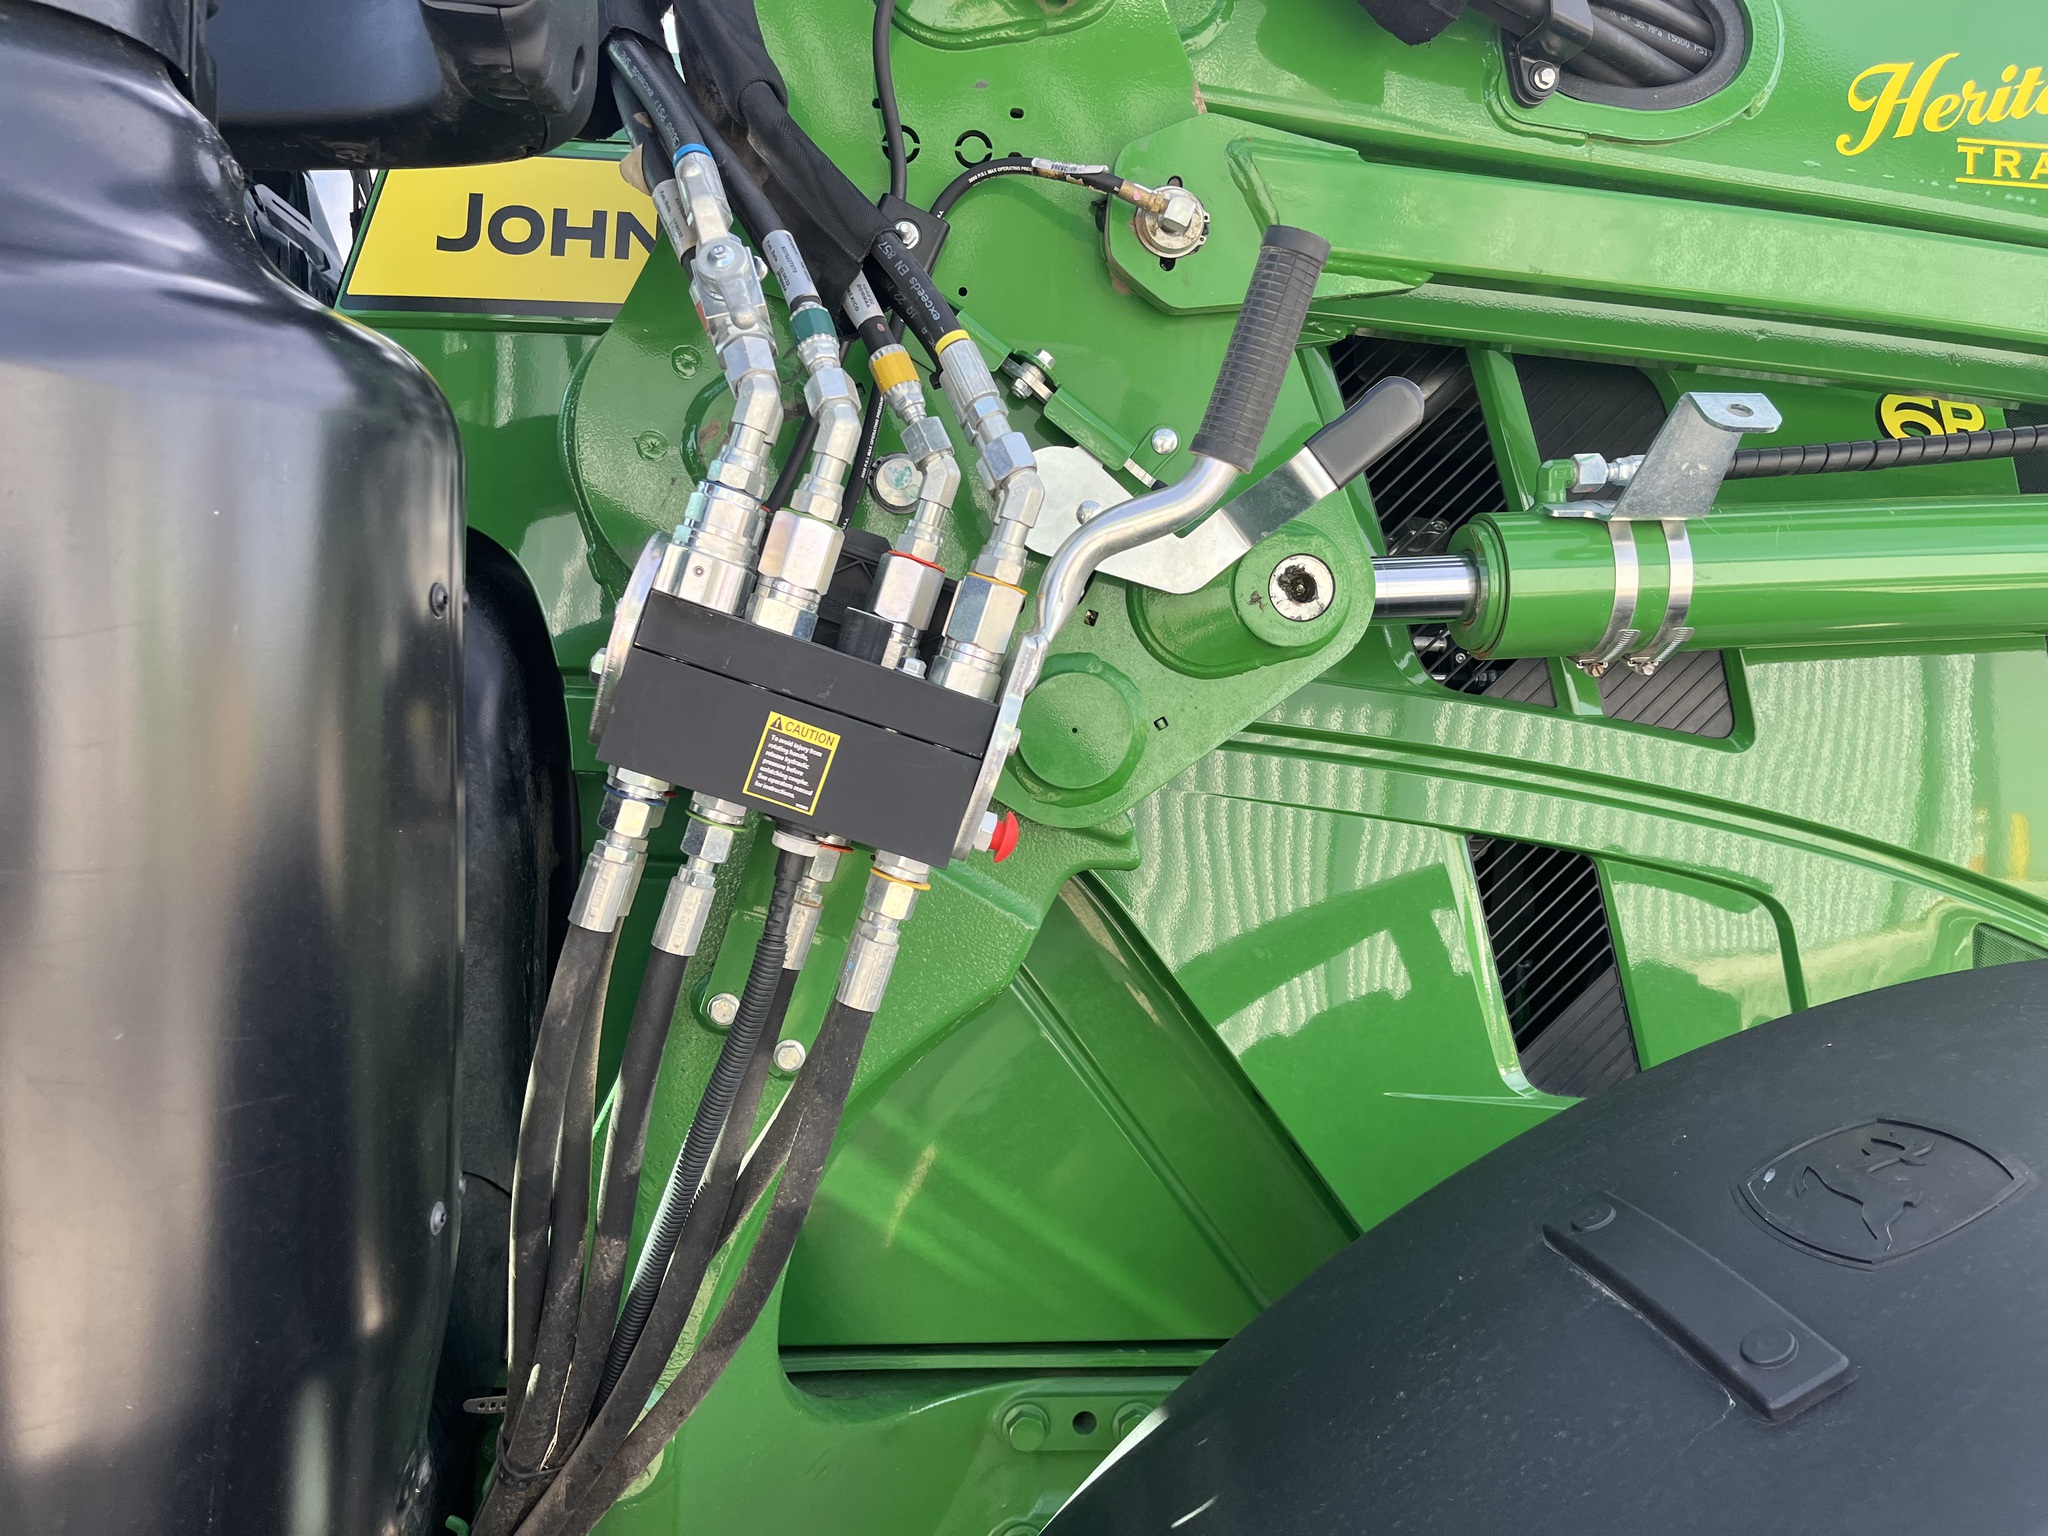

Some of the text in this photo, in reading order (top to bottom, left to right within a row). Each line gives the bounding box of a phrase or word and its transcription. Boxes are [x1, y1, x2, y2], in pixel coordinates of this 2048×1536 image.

[654, 100, 668, 121] PSI)
[666, 122, 680, 149] (3000
[436, 192, 662, 260] JOHN
[878, 241, 896, 260] 857
[894, 260, 910, 277] EN
[909, 276, 941, 320] exceeds
[785, 721, 835, 746] CAUTION
[768, 743, 789, 755] rotating
[778, 737, 794, 747] avoid
[793, 742, 809, 754] injury
[809, 748, 822, 757] from
[762, 759, 804, 776] pressure before
[765, 750, 809, 769] release hydraulic
[757, 772, 767, 780] See
[793, 785, 813, 796] manual
